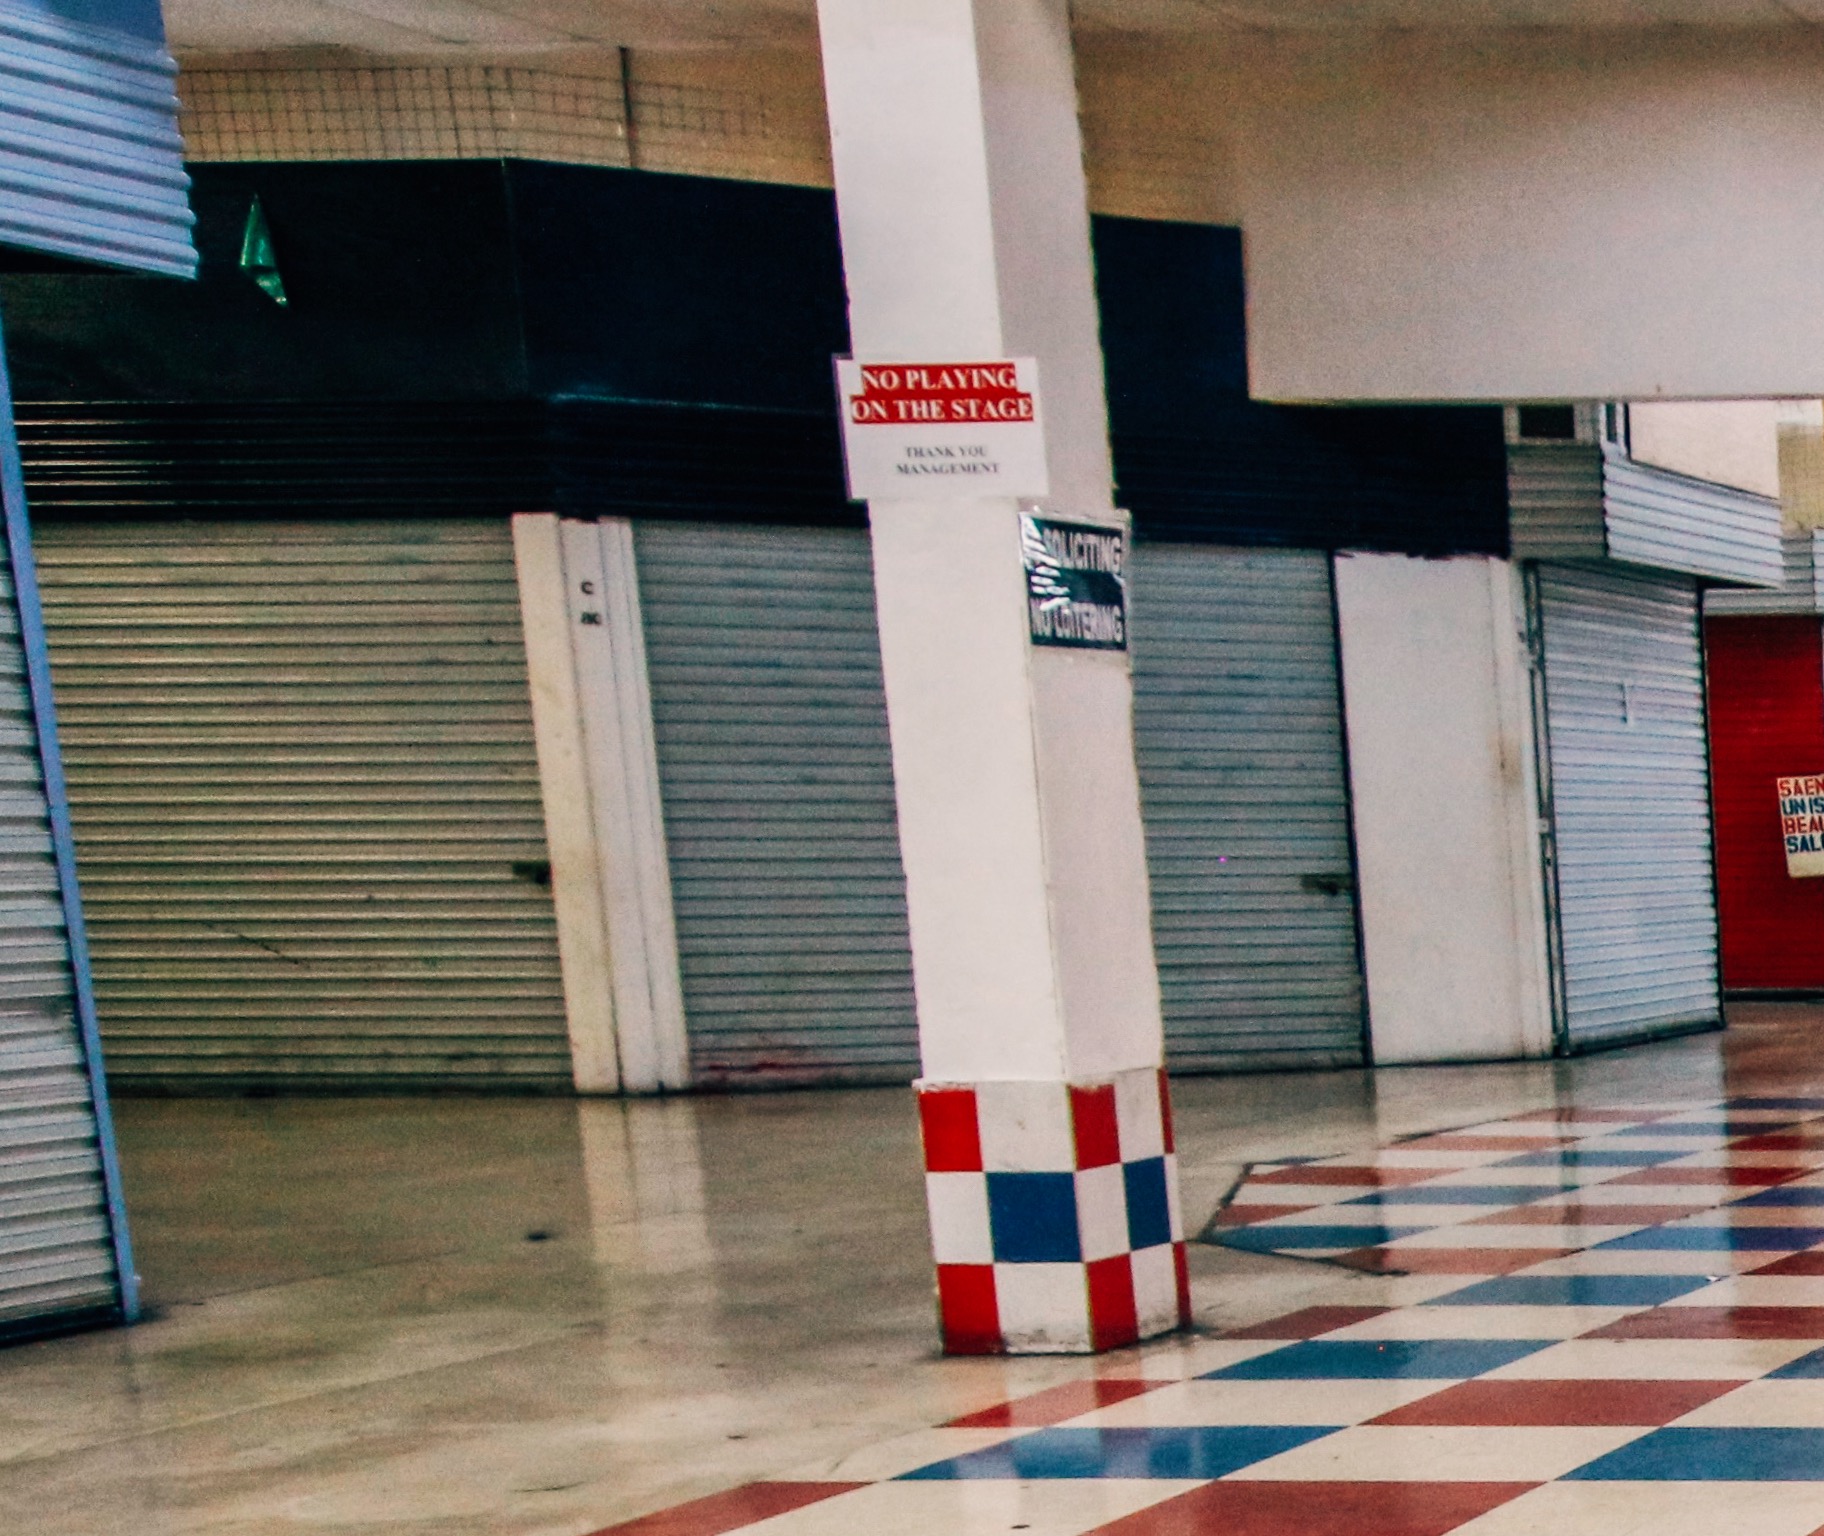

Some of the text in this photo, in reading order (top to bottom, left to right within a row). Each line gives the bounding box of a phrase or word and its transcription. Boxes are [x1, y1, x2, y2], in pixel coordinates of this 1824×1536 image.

[861, 367, 1015, 390] NO PLAYING
[852, 397, 1033, 421] ON THE STAGE
[905, 446, 987, 458] THANK YOU
[897, 462, 999, 475] MANAGEMENT
[1043, 526, 1121, 574] SOLICITING
[1054, 602, 1123, 643] LOITERING
